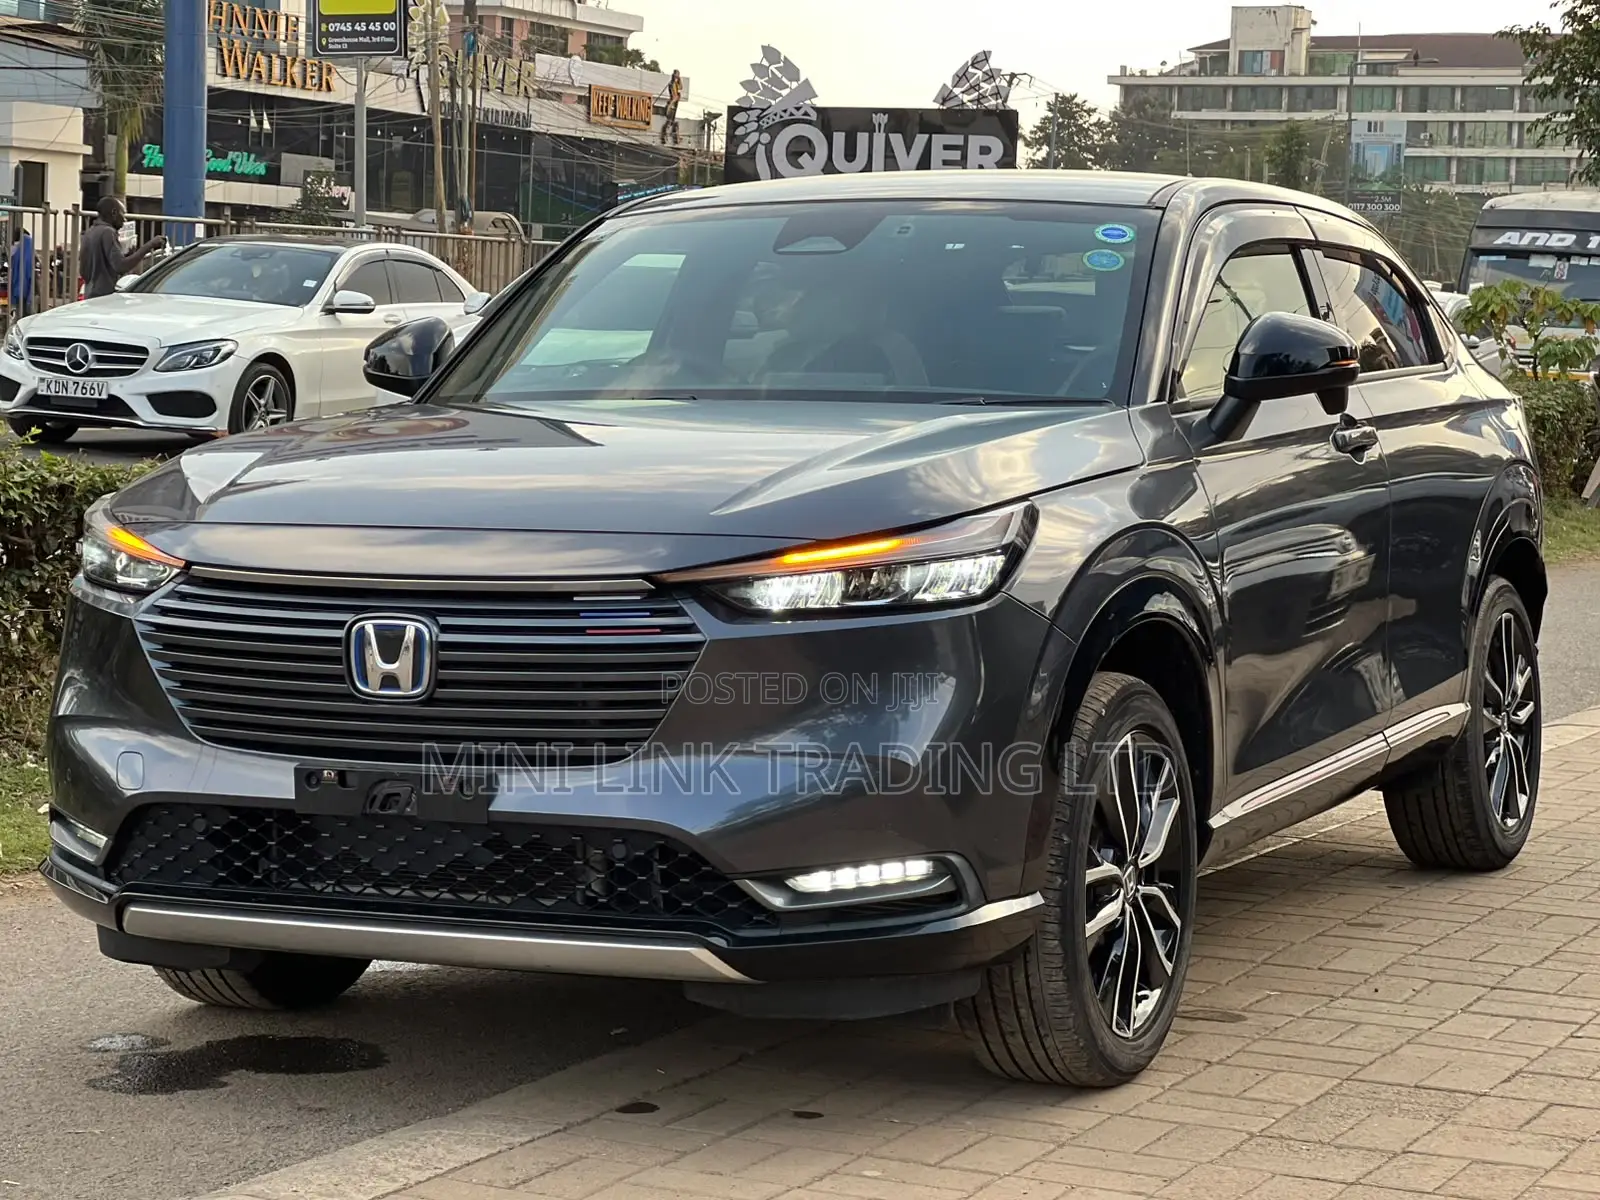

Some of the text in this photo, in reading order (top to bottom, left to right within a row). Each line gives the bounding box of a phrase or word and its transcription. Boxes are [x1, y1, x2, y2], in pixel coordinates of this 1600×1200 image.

[328, 22, 396, 32] 0745 45 45 00
[220, 36, 336, 92] WALKER
[592, 90, 652, 122] KEEP WALKING
[772, 113, 1004, 178] QUIVER
[1366, 203, 1383, 211] 300
[45, 379, 105, 397] KDN 766V
